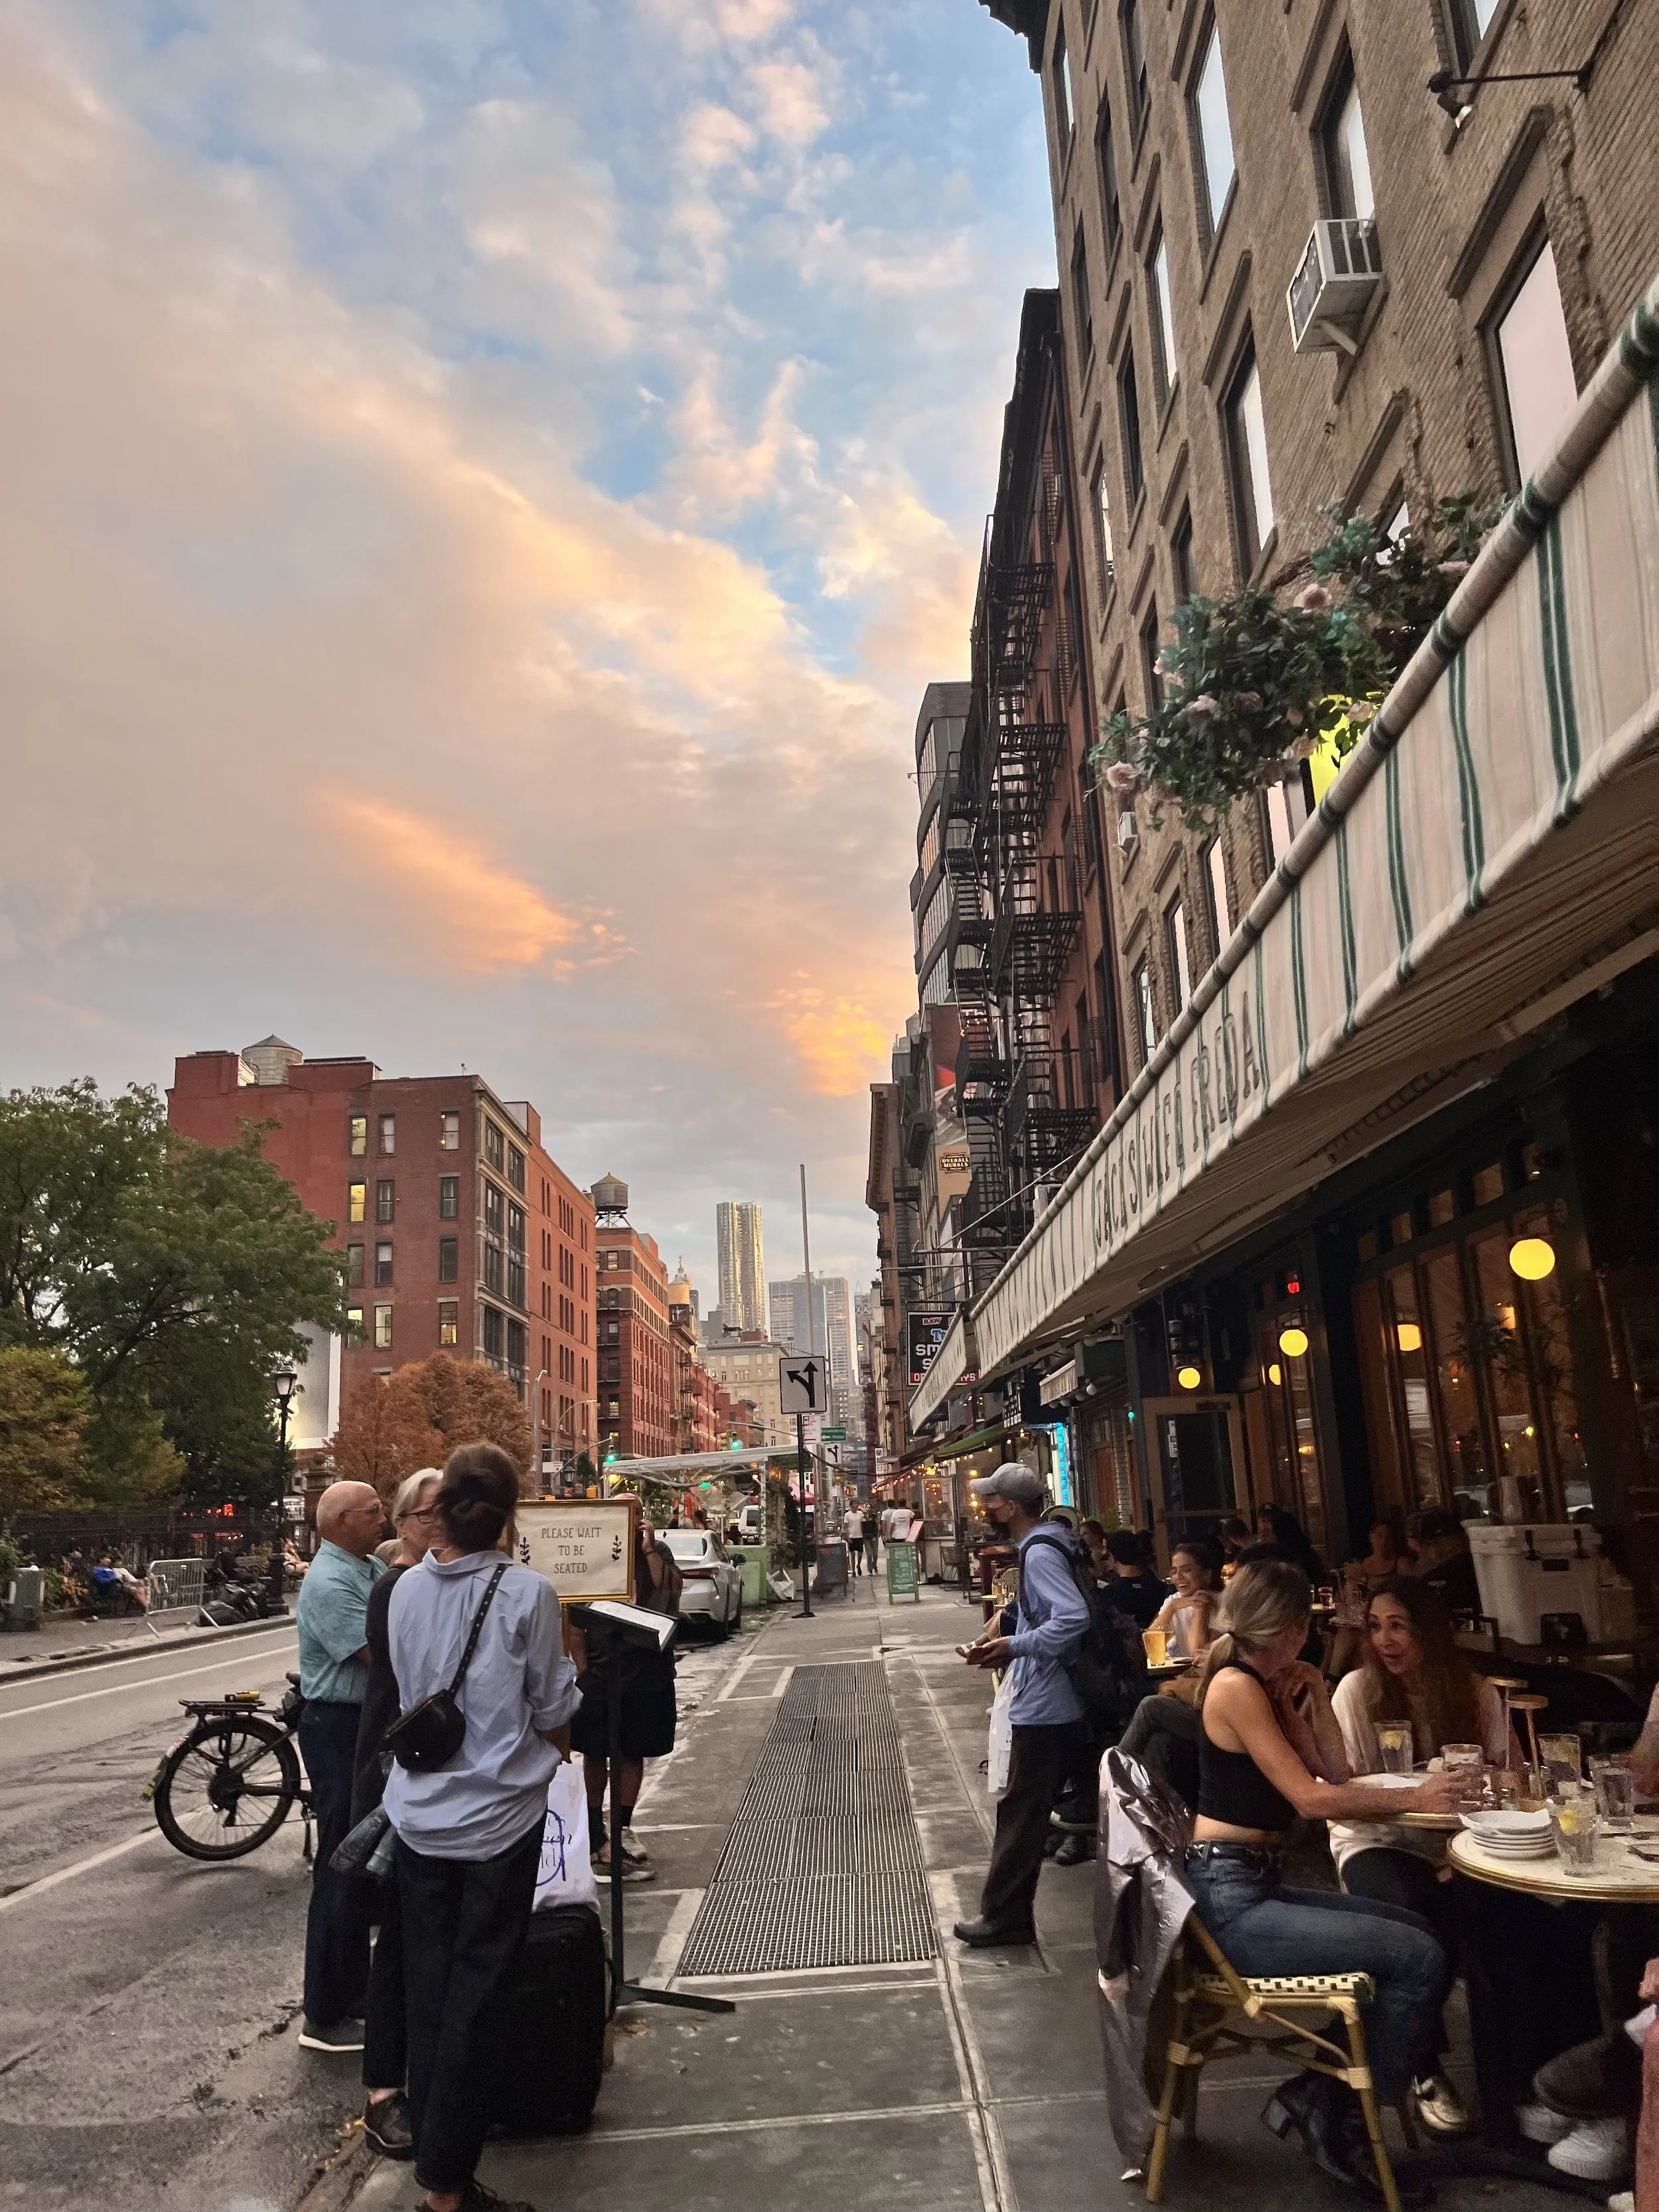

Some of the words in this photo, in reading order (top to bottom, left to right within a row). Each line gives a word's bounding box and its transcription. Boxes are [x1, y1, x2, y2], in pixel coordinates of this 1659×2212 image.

[1190, 990, 1260, 1153] FREDA
[922, 1317, 942, 1325] RAW
[541, 1528, 573, 1538] PLEASE
[577, 1527, 601, 1538] WAIT
[558, 1545, 570, 1556] TO
[573, 1545, 585, 1556] BE
[553, 1562, 587, 1574] SEATED
